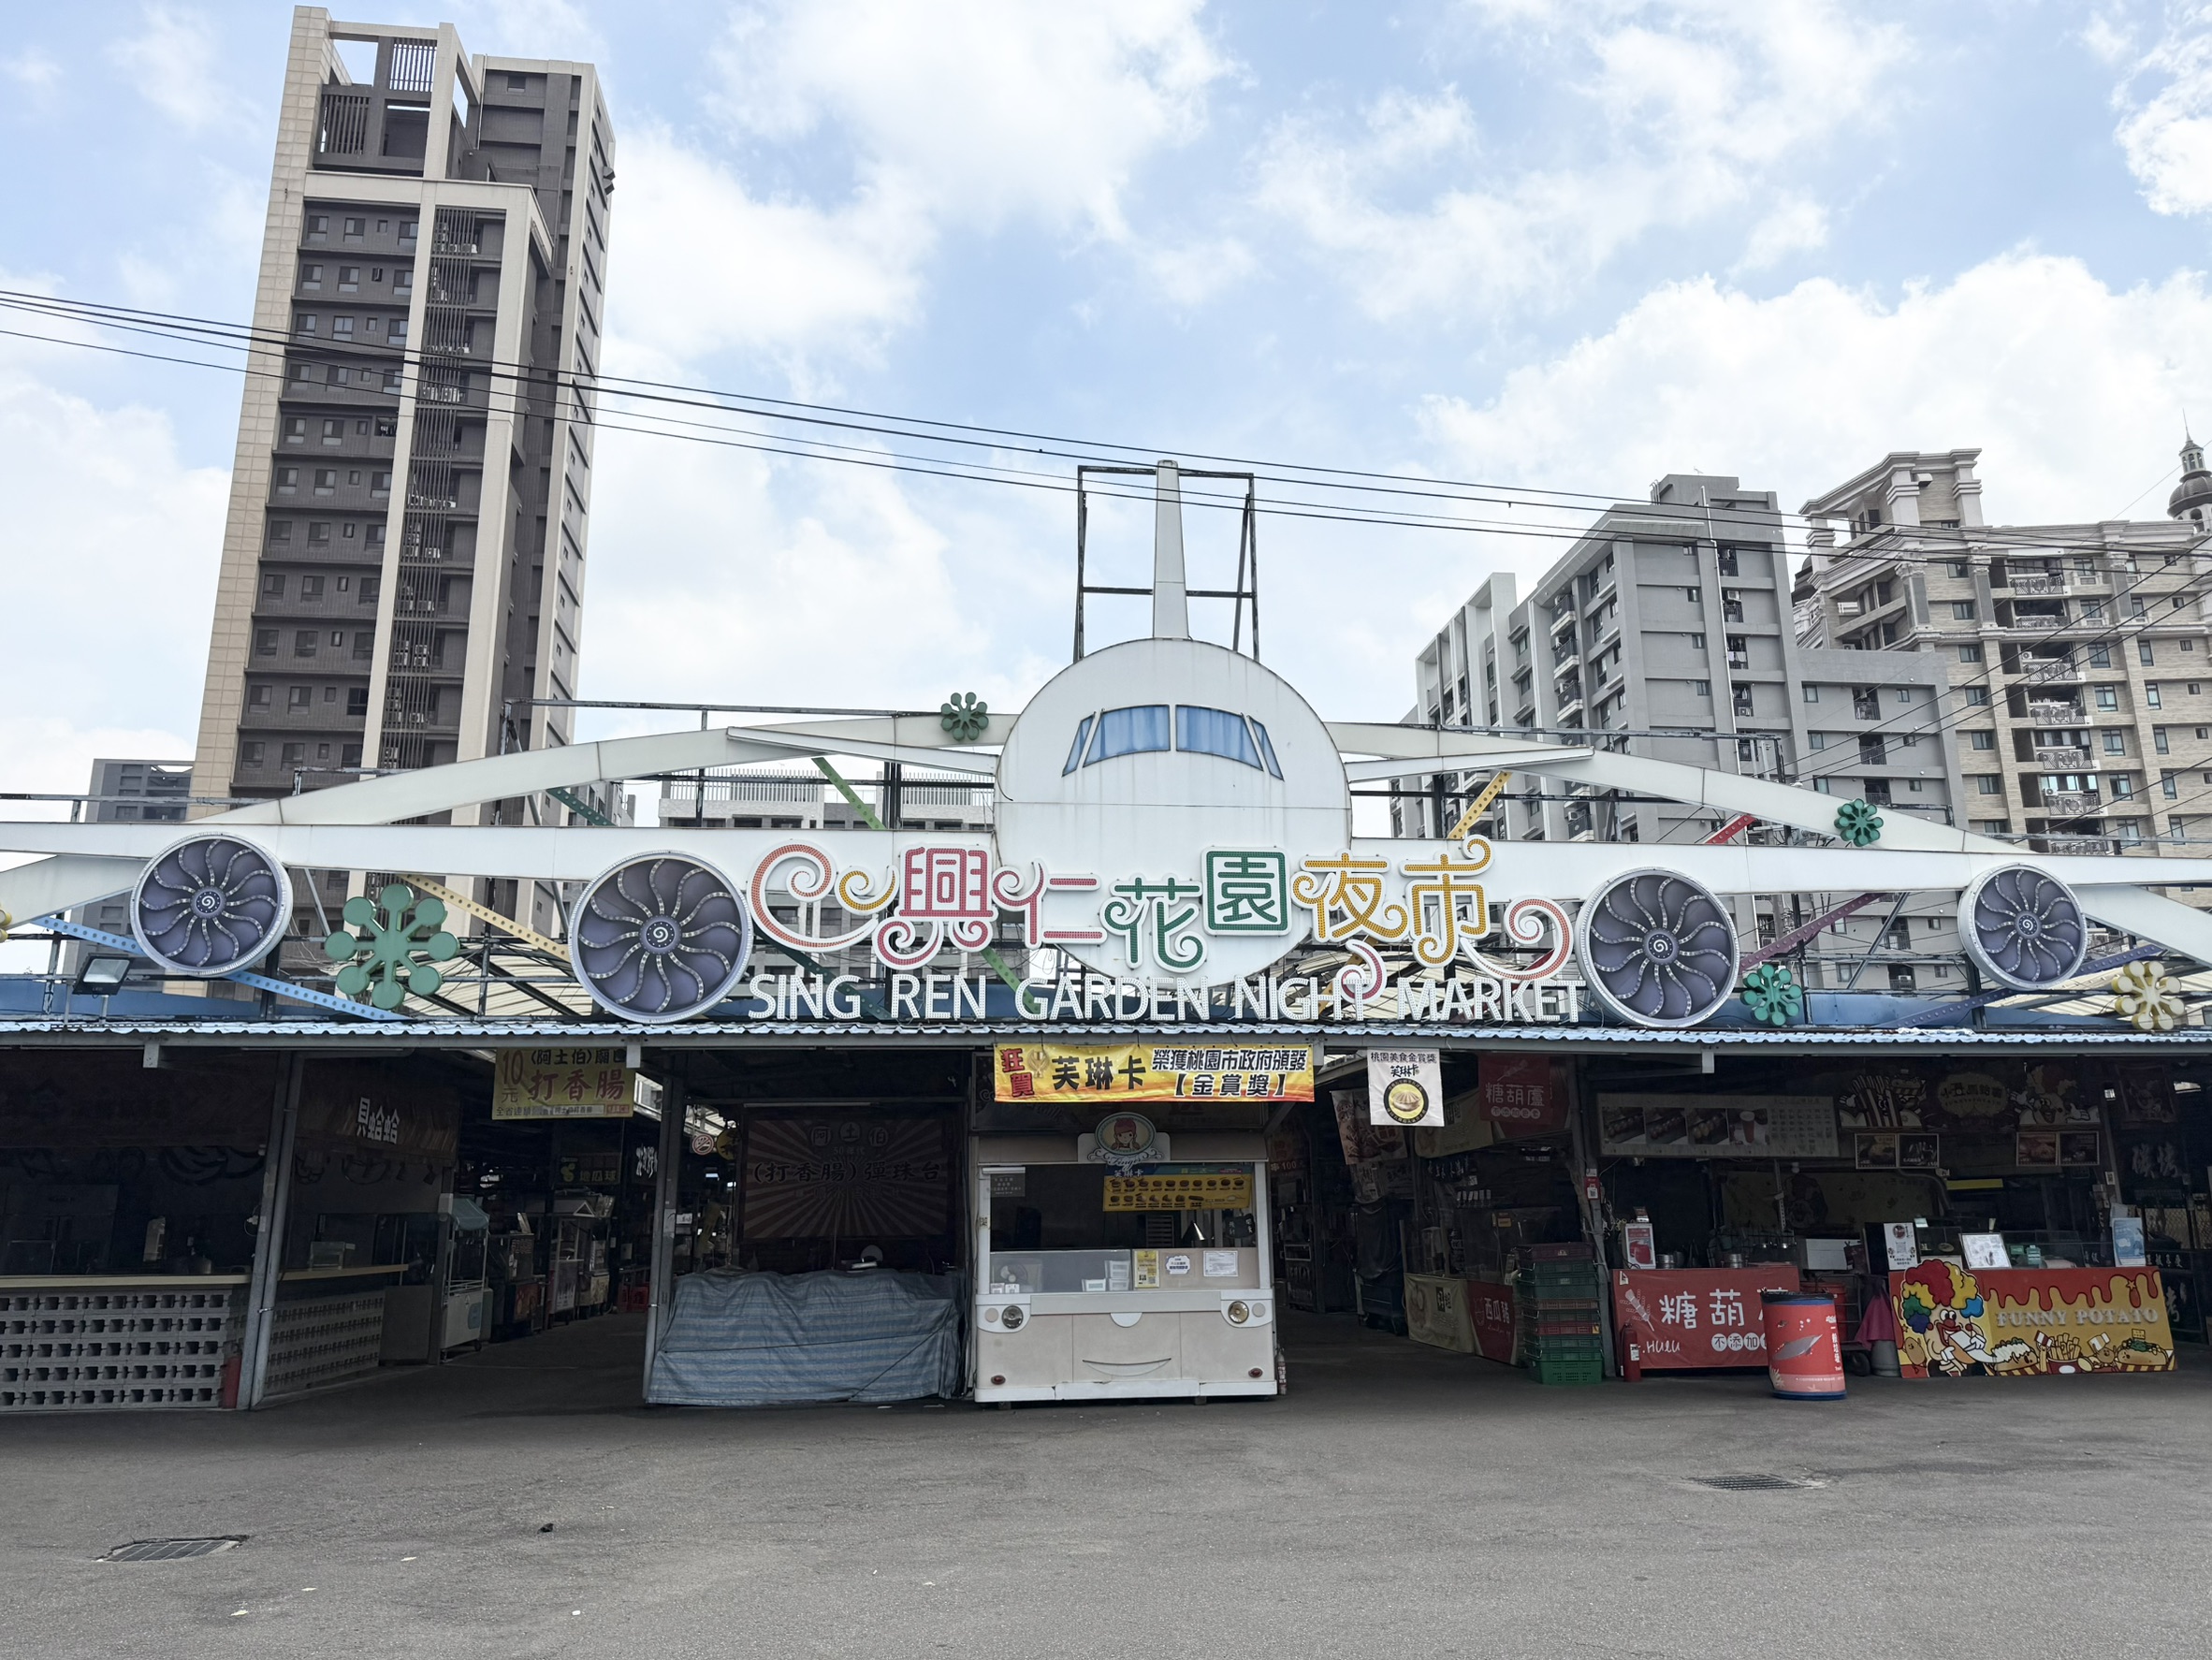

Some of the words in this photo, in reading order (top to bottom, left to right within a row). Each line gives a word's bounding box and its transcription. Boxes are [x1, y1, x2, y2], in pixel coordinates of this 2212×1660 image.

[874, 836, 1493, 972] 興仁花園夜市
[749, 974, 861, 1020] SING
[891, 974, 986, 1020] REN
[1014, 975, 1210, 1022] GARDEN
[1233, 975, 1372, 1022] NIGHT
[1397, 977, 1586, 1023] MARKET
[502, 1049, 525, 1085] 10
[999, 1046, 1036, 1098] 狂賀
[1051, 1055, 1147, 1090] 芙琳卡
[1152, 1047, 1308, 1072] 榮獲桃園市政府頒發
[501, 1087, 519, 1103] 元
[527, 1068, 626, 1102] 打香腸
[1485, 1082, 1545, 1107] 糖葫蘆
[1658, 1288, 1789, 1330] 糖葫
[1996, 1310, 2067, 1328] FUNNY
[2075, 1307, 2160, 1326] POTATO
[1711, 1332, 1767, 1351] 不添加
